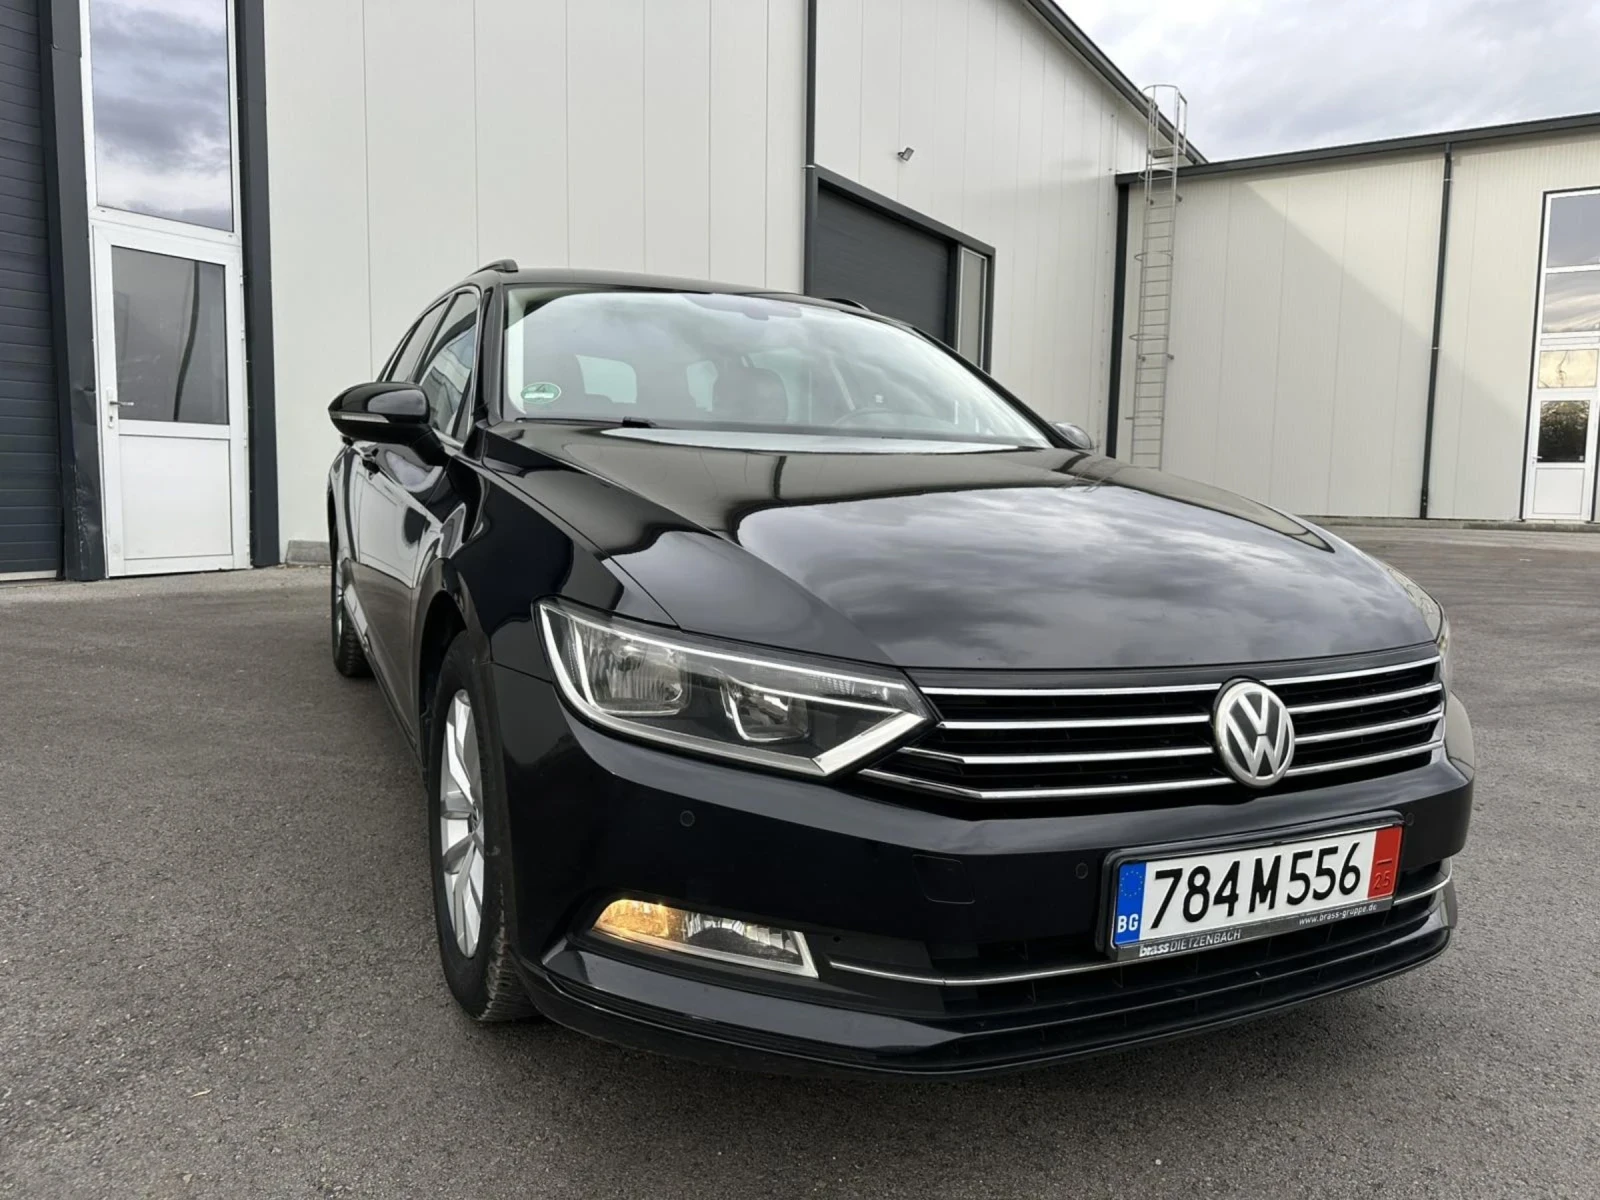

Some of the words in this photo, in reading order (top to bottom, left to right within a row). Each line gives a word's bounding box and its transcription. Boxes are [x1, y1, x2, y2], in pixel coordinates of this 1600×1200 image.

[1373, 870, 1390, 889] 25
[1117, 912, 1139, 933] BG
[1299, 904, 1377, 925] www.brass-gruppe.de
